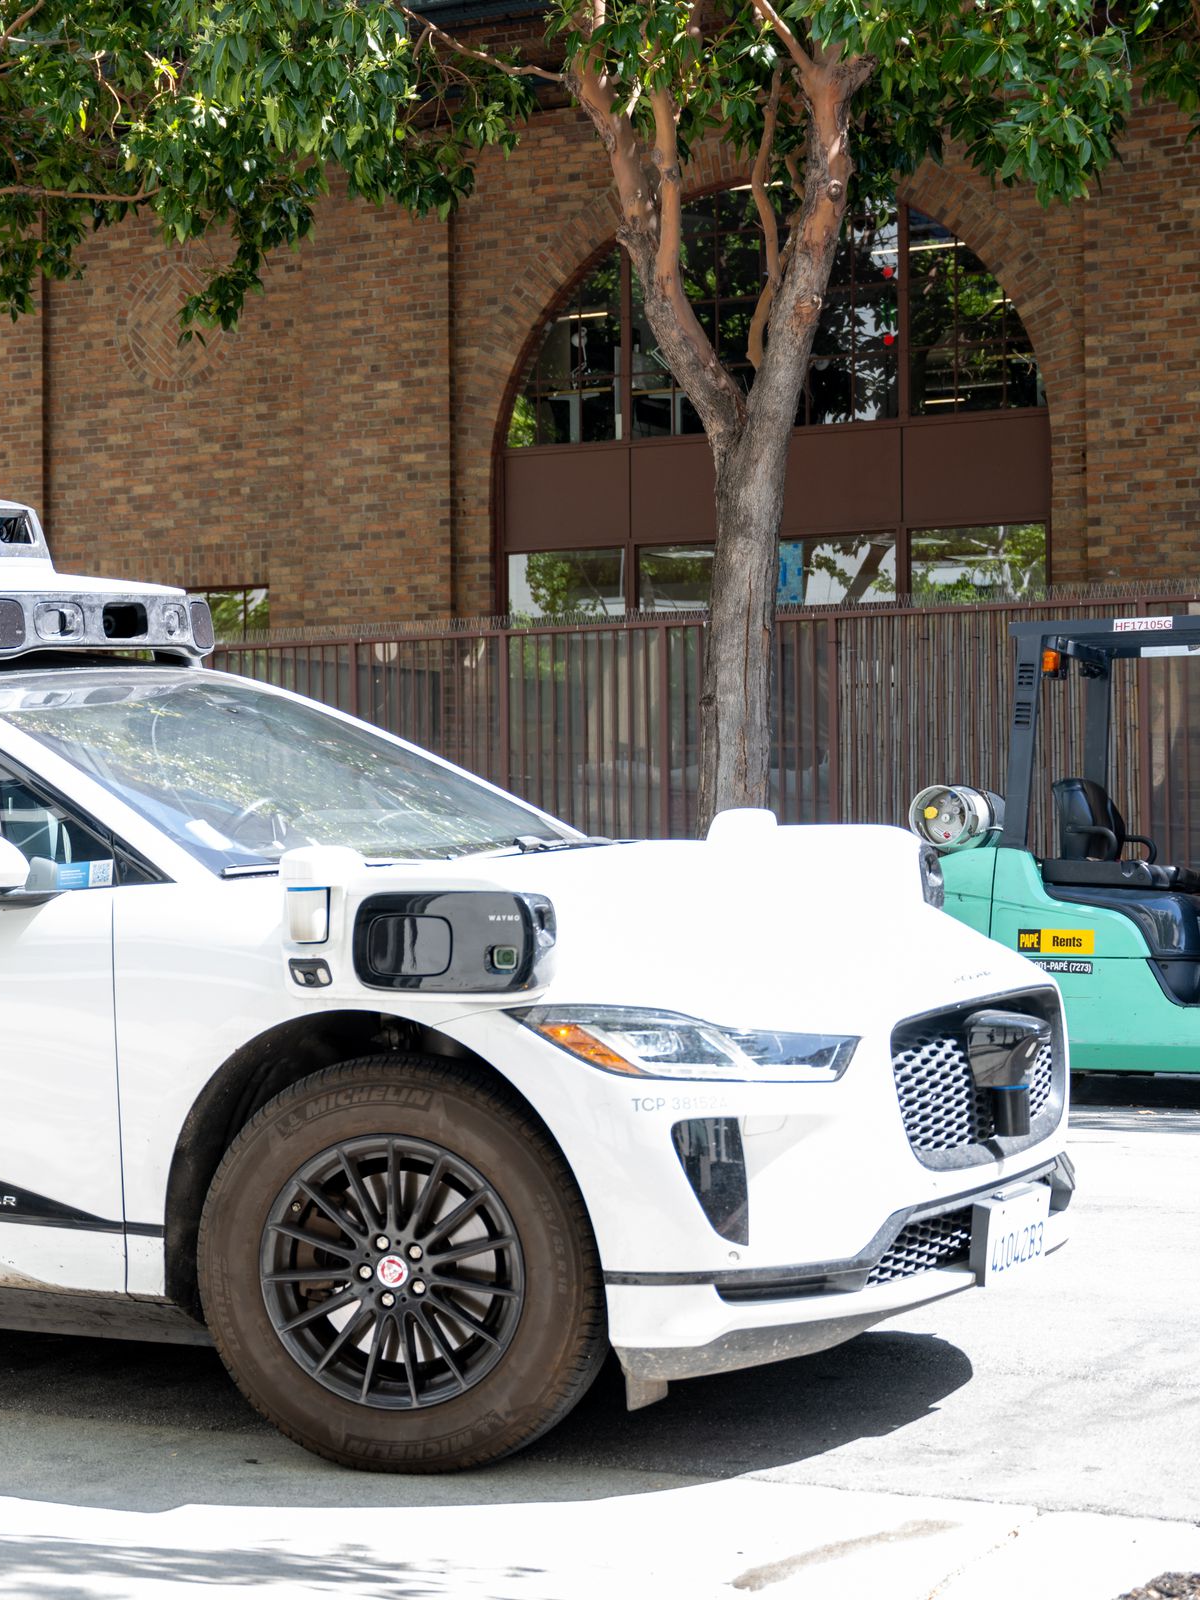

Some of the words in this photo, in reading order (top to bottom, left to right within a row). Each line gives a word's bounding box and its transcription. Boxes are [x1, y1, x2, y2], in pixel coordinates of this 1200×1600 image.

[1115, 620, 1172, 631] HF17105G
[1052, 935, 1082, 947] Rents
[1069, 962, 1092, 974] (7273)
[305, 1085, 432, 1119] MICHELIN
[631, 1097, 666, 1112] TCP
[992, 1221, 1044, 1272] 41042B3
